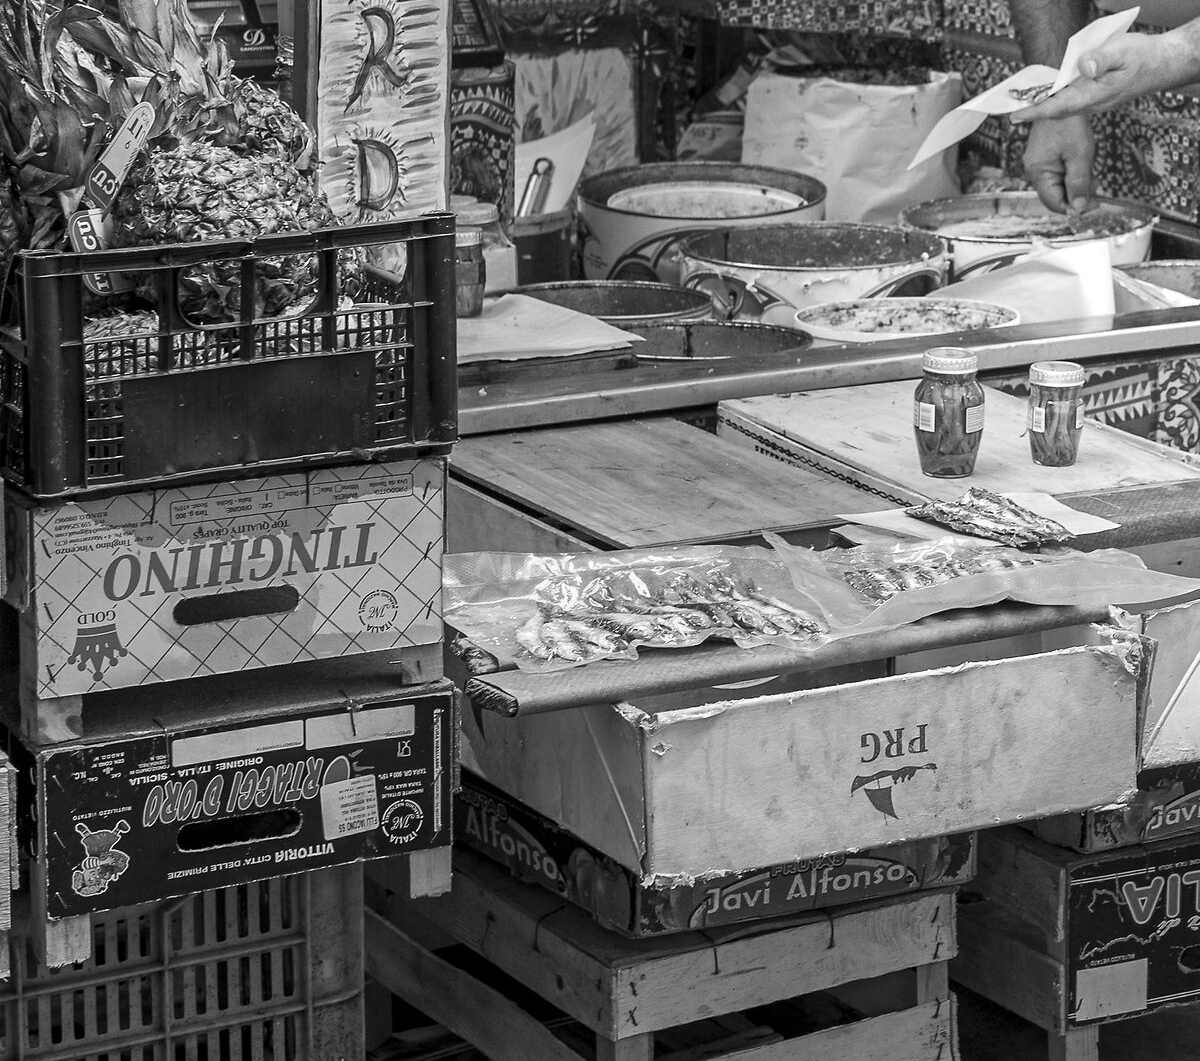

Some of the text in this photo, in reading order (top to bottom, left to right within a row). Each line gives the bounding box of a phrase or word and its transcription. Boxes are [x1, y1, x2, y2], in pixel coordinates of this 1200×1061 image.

[192, 519, 289, 540] TOP QUALITY GRAPES
[55, 545, 94, 555] Vincenzo
[95, 539, 131, 550] Tinghino
[103, 522, 377, 601] TINGHINO
[77, 609, 116, 625] GOLD
[366, 621, 393, 634] ITALIA
[861, 724, 928, 763] PRG
[128, 756, 264, 786] ORIGINE: ITALIA SICILIA
[142, 774, 224, 828] D'ORO
[389, 831, 418, 845] ITALIA
[465, 806, 558, 880] Alfonso
[275, 842, 335, 863] VITTORIA
[167, 865, 209, 880] PRIMIZIE
[210, 860, 241, 871] DELLE
[769, 853, 847, 878] FRUTAS
[706, 864, 906, 915] Javi Alfonso
[1154, 917, 1181, 940] di
